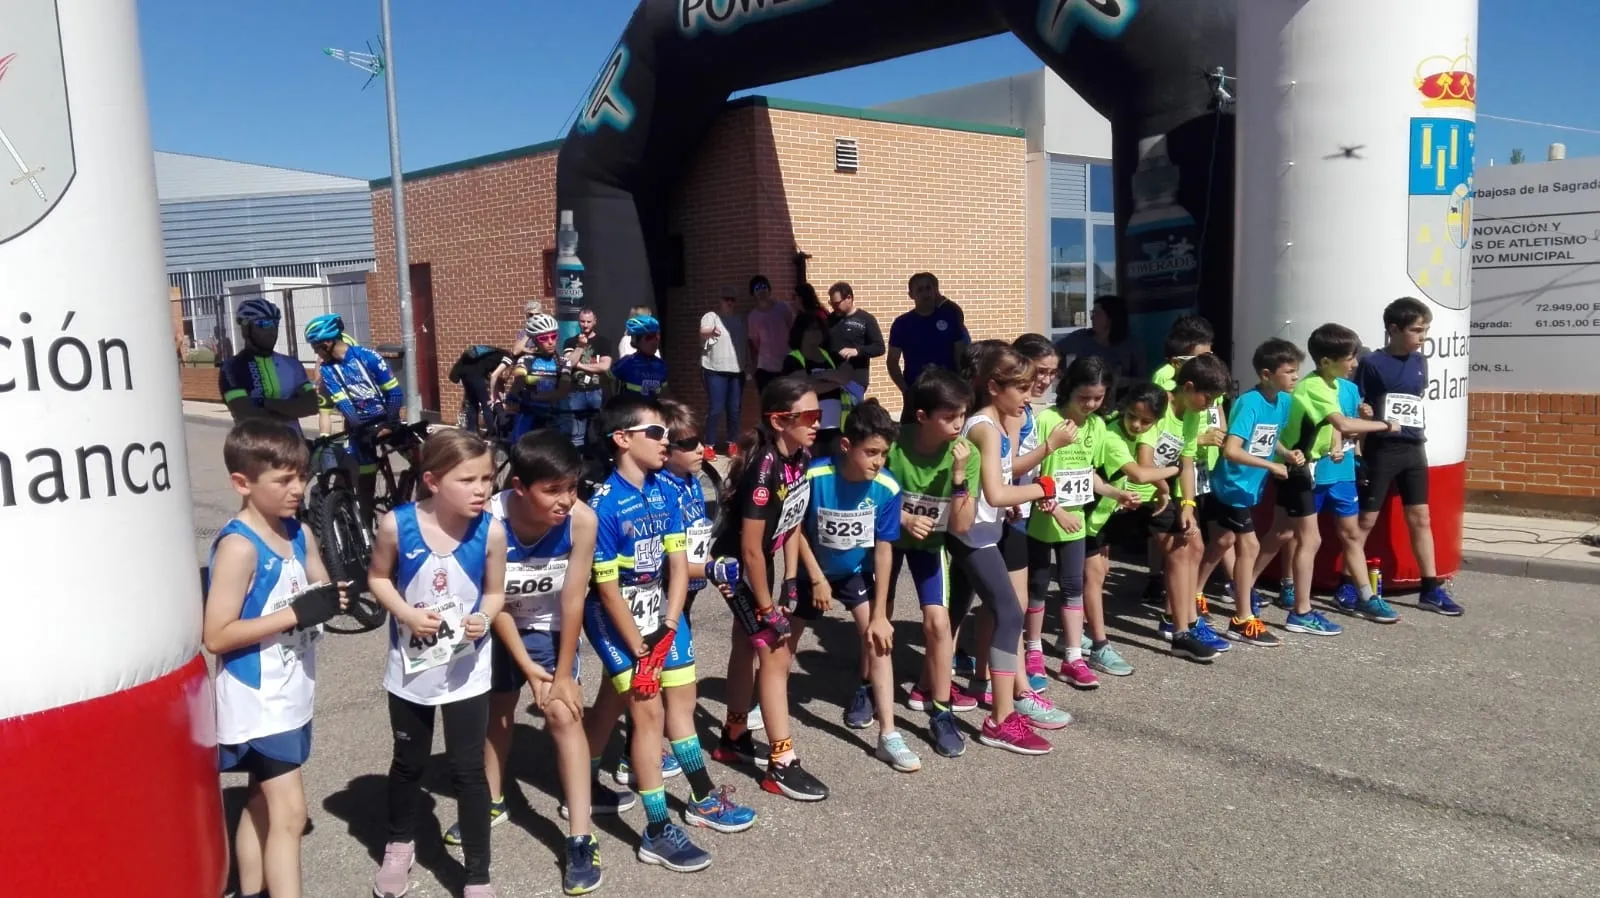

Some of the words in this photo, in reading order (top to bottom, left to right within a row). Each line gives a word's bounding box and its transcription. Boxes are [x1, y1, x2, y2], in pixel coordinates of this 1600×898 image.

[1519, 185, 1535, 195] de
[1538, 184, 1549, 193] la
[1552, 222, 1561, 231] Y
[1487, 240, 1505, 249] DE
[1508, 235, 1588, 249] ATLETISMO
[1498, 250, 1575, 263] MUNICIPAL
[1420, 369, 1468, 401] alam
[1391, 402, 1418, 416] 524
[1061, 478, 1090, 494] 413
[902, 501, 939, 520] 508
[825, 520, 863, 536] 523
[504, 576, 553, 595] 506
[409, 620, 455, 650] 404
